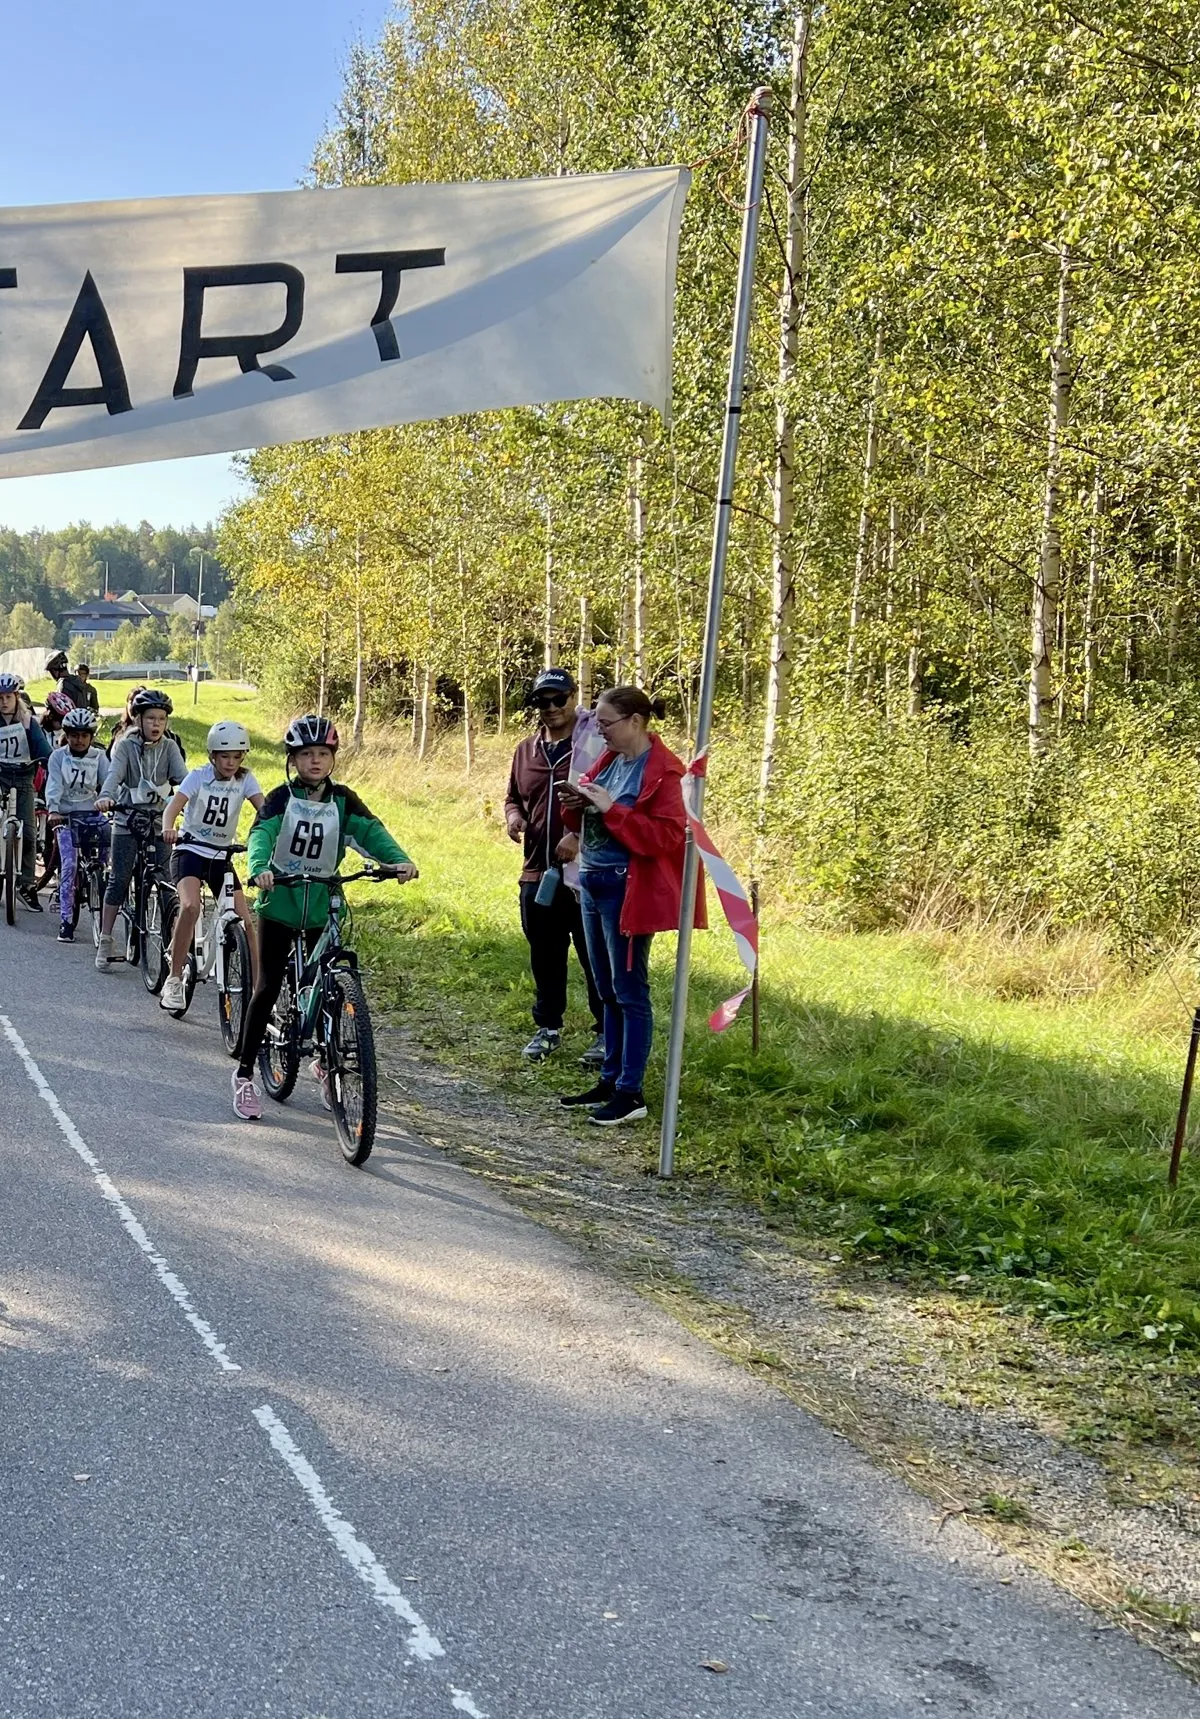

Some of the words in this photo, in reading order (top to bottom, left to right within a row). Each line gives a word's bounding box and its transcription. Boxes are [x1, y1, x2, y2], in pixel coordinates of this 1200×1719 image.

[0, 736, 22, 758] 72
[70, 768, 86, 788] 71
[202, 795, 229, 828] 69
[289, 820, 325, 860] 68
